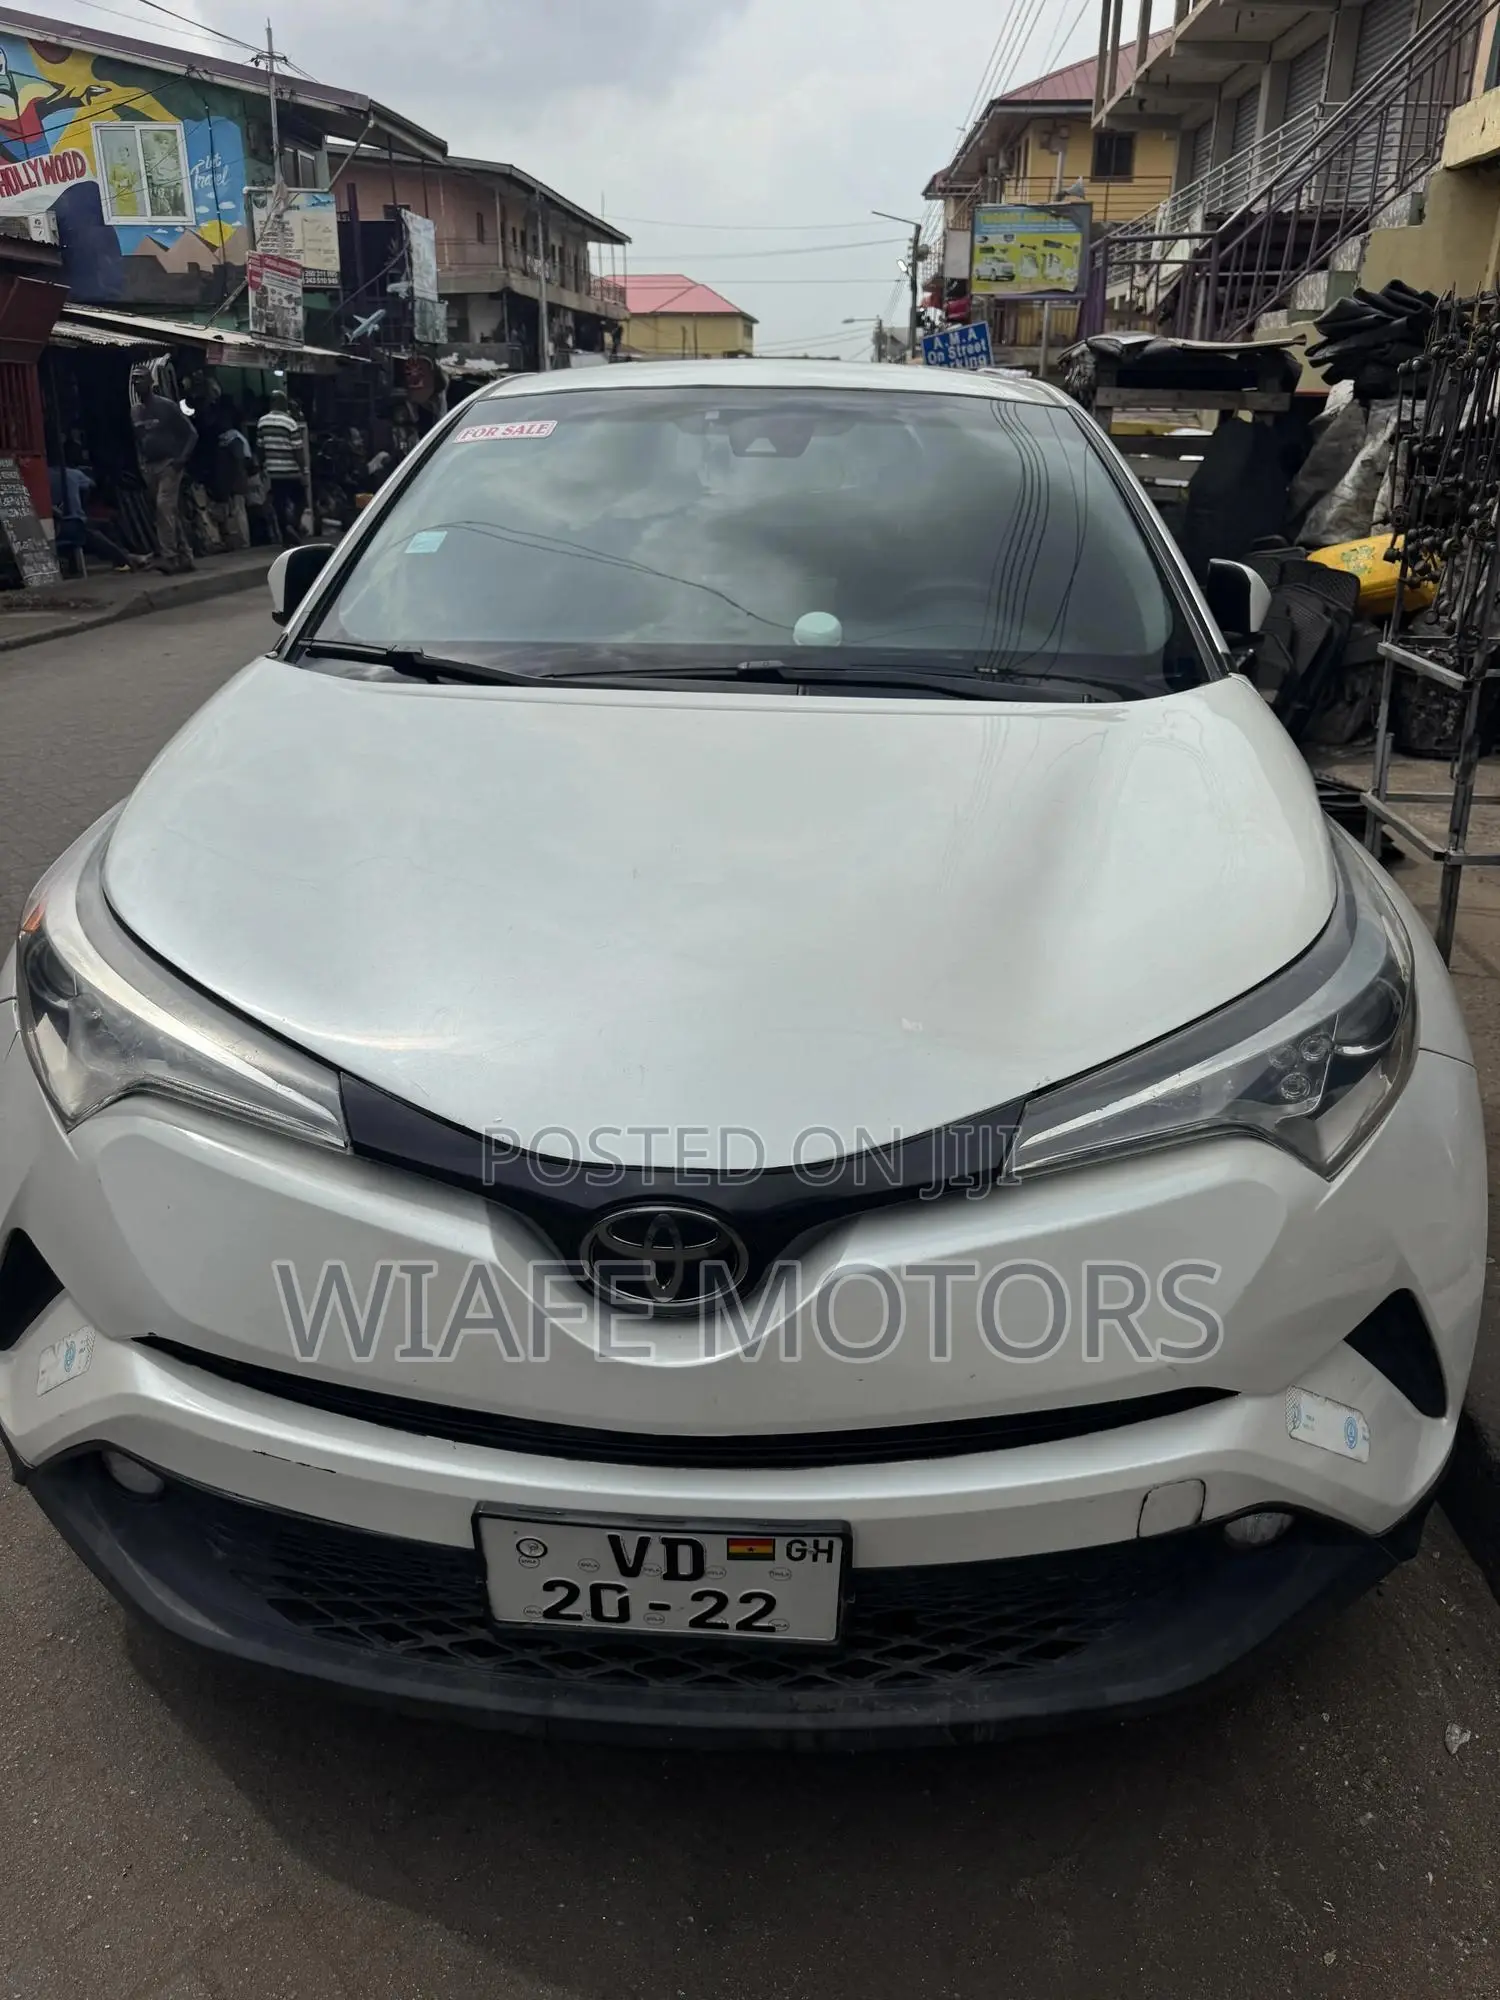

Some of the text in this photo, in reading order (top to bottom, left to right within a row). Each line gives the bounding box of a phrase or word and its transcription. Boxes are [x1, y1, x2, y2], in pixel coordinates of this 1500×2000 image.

[0, 151, 86, 197] HOLLYWOOD
[927, 350, 945, 365] On
[948, 338, 987, 359] Street
[461, 423, 549, 439] FOR SALE
[606, 1533, 834, 1581] VD GH
